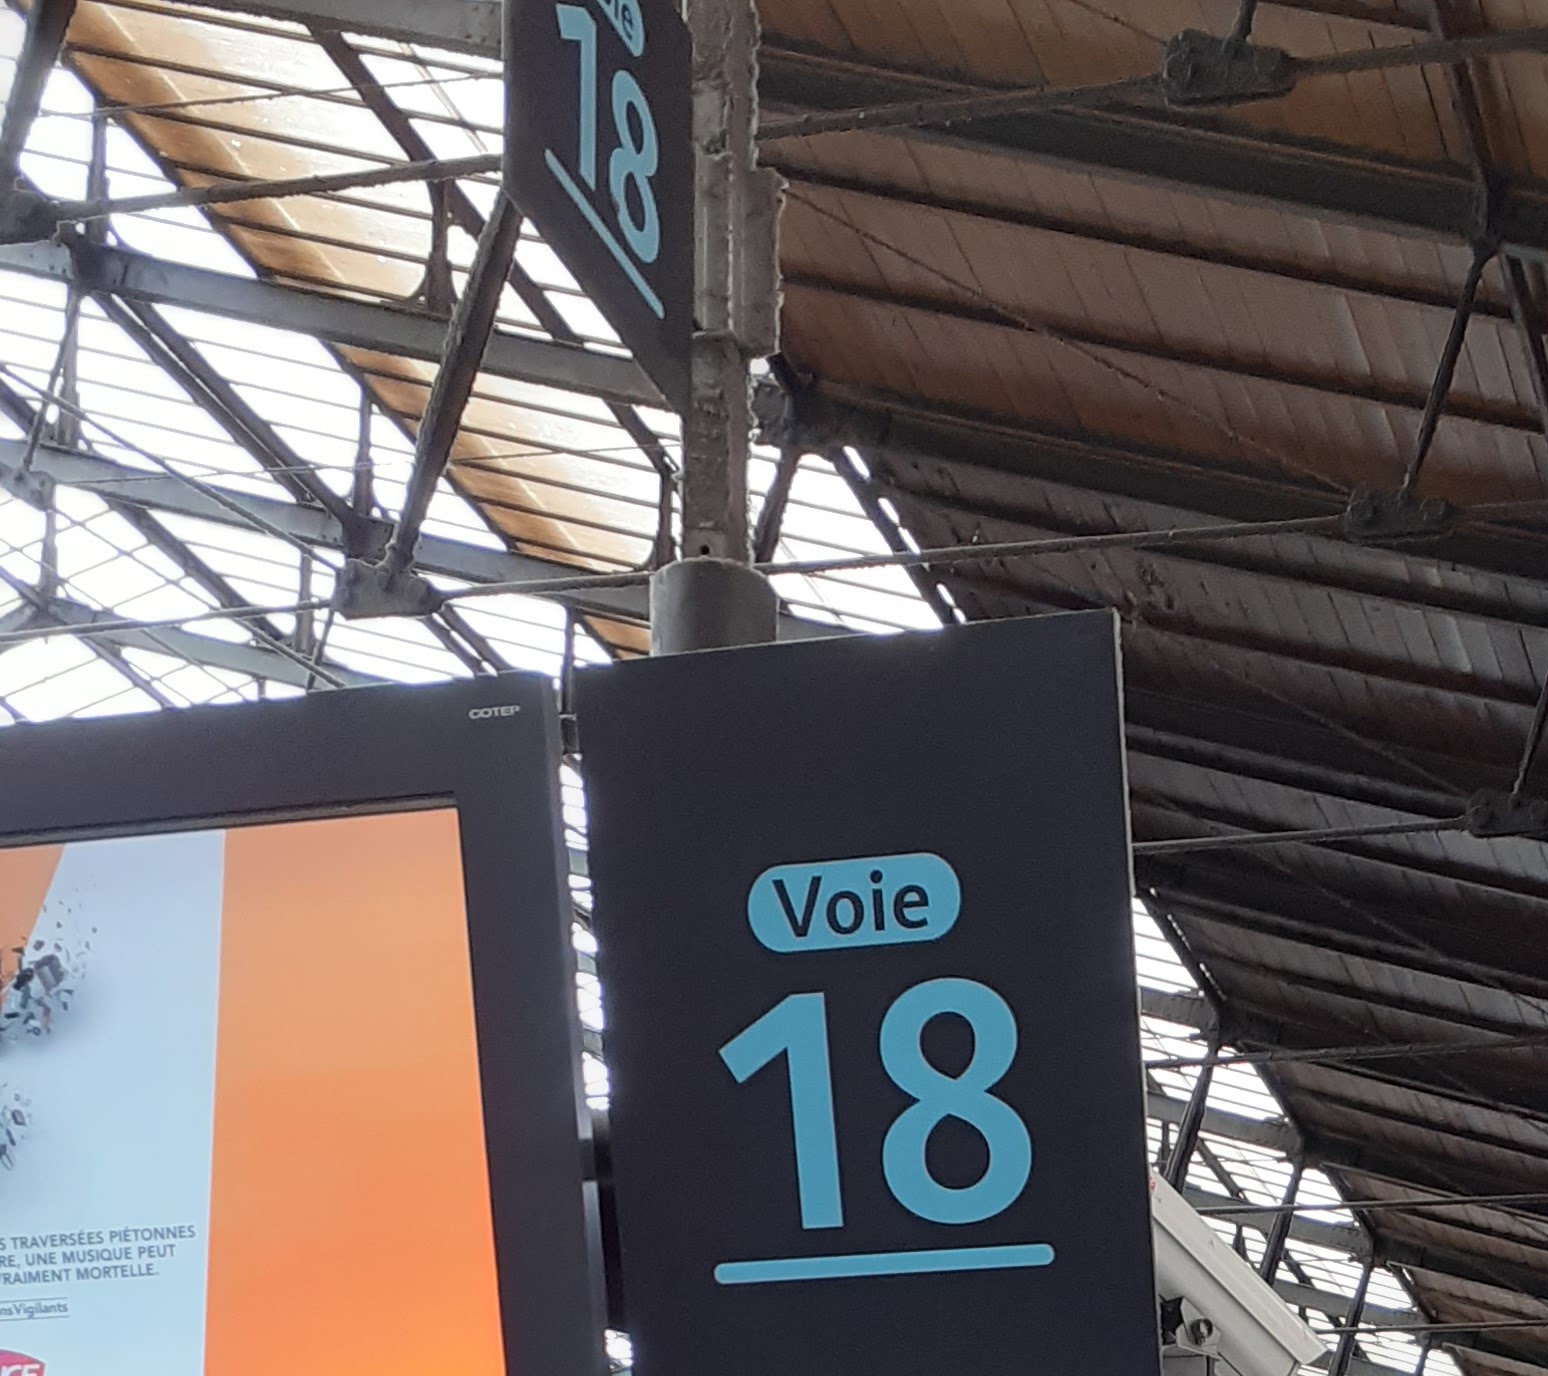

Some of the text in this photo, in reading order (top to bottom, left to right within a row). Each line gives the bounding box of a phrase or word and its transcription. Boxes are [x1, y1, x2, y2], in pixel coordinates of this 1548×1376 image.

[556, 3, 660, 263] 18
[772, 869, 930, 938] Voie
[719, 977, 1032, 1230] 18
[10, 1231, 104, 1250] TRAVERSÉES
[108, 1225, 196, 1243] PIÉTONNES
[25, 1252, 57, 1266] UNE
[62, 1247, 132, 1265] MUSIQUE
[137, 1243, 176, 1259] PEUT
[76, 1263, 160, 1280] MORTELLE.
